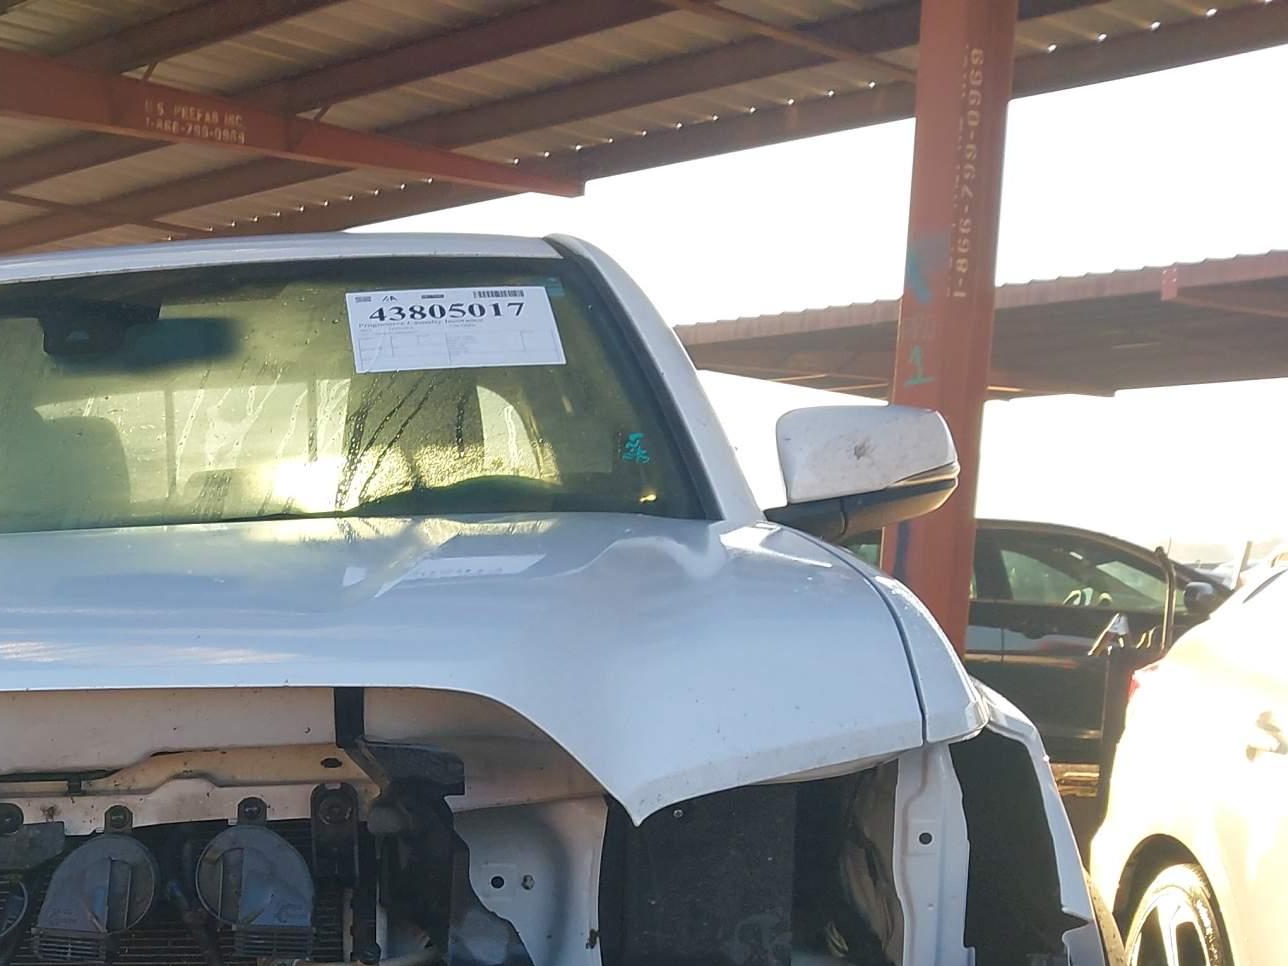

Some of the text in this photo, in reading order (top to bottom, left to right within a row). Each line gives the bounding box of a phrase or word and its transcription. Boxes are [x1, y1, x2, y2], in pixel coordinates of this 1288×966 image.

[174, 104, 219, 124] PREFAB
[952, 48, 984, 298] 1-866-799-0969
[368, 302, 525, 322] 43805017
